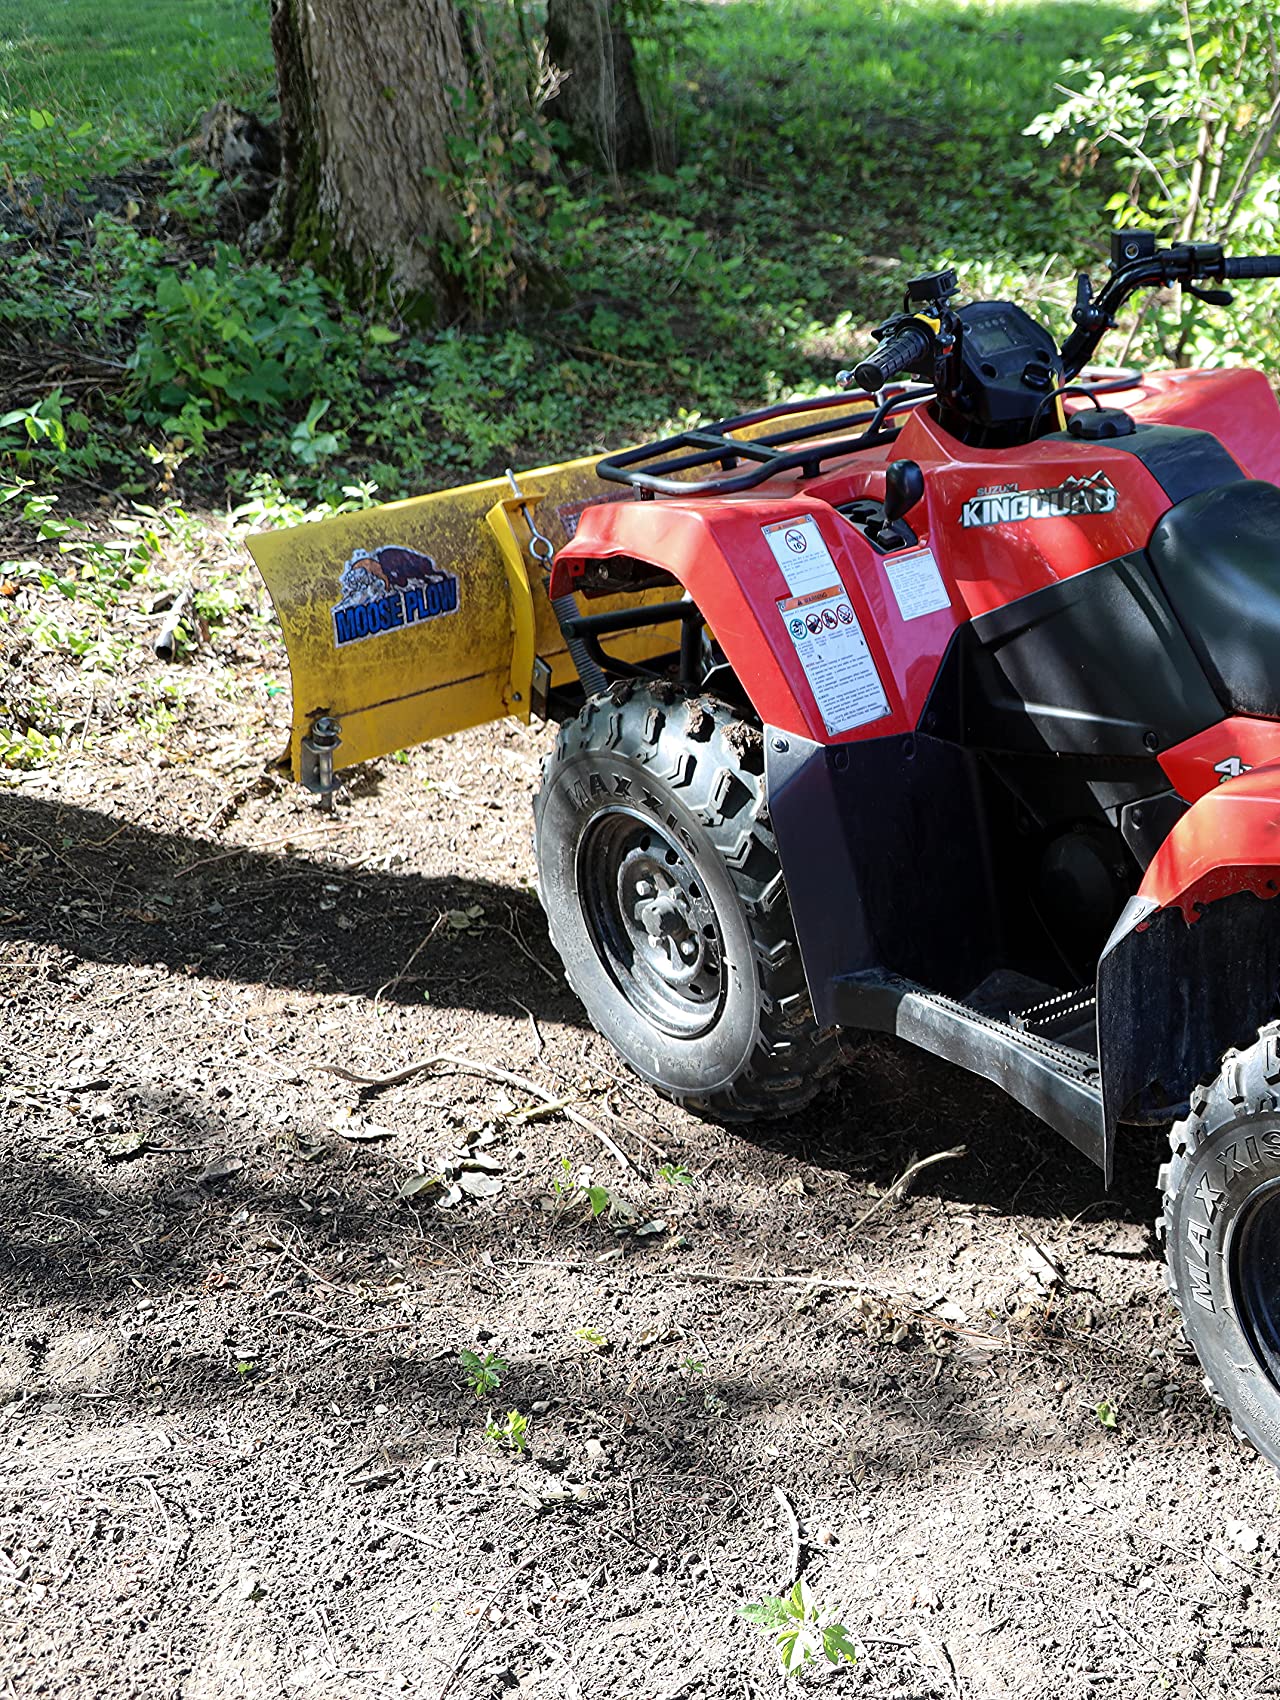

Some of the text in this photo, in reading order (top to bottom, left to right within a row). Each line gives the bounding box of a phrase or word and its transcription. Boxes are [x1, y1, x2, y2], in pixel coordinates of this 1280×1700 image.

[962, 487, 1117, 528] KINGQUAD
[976, 483, 1019, 496] SUZUKI
[793, 543, 802, 551] 16
[335, 577, 457, 644] MOOSE PLOW
[566, 772, 700, 857] MAXXIS
